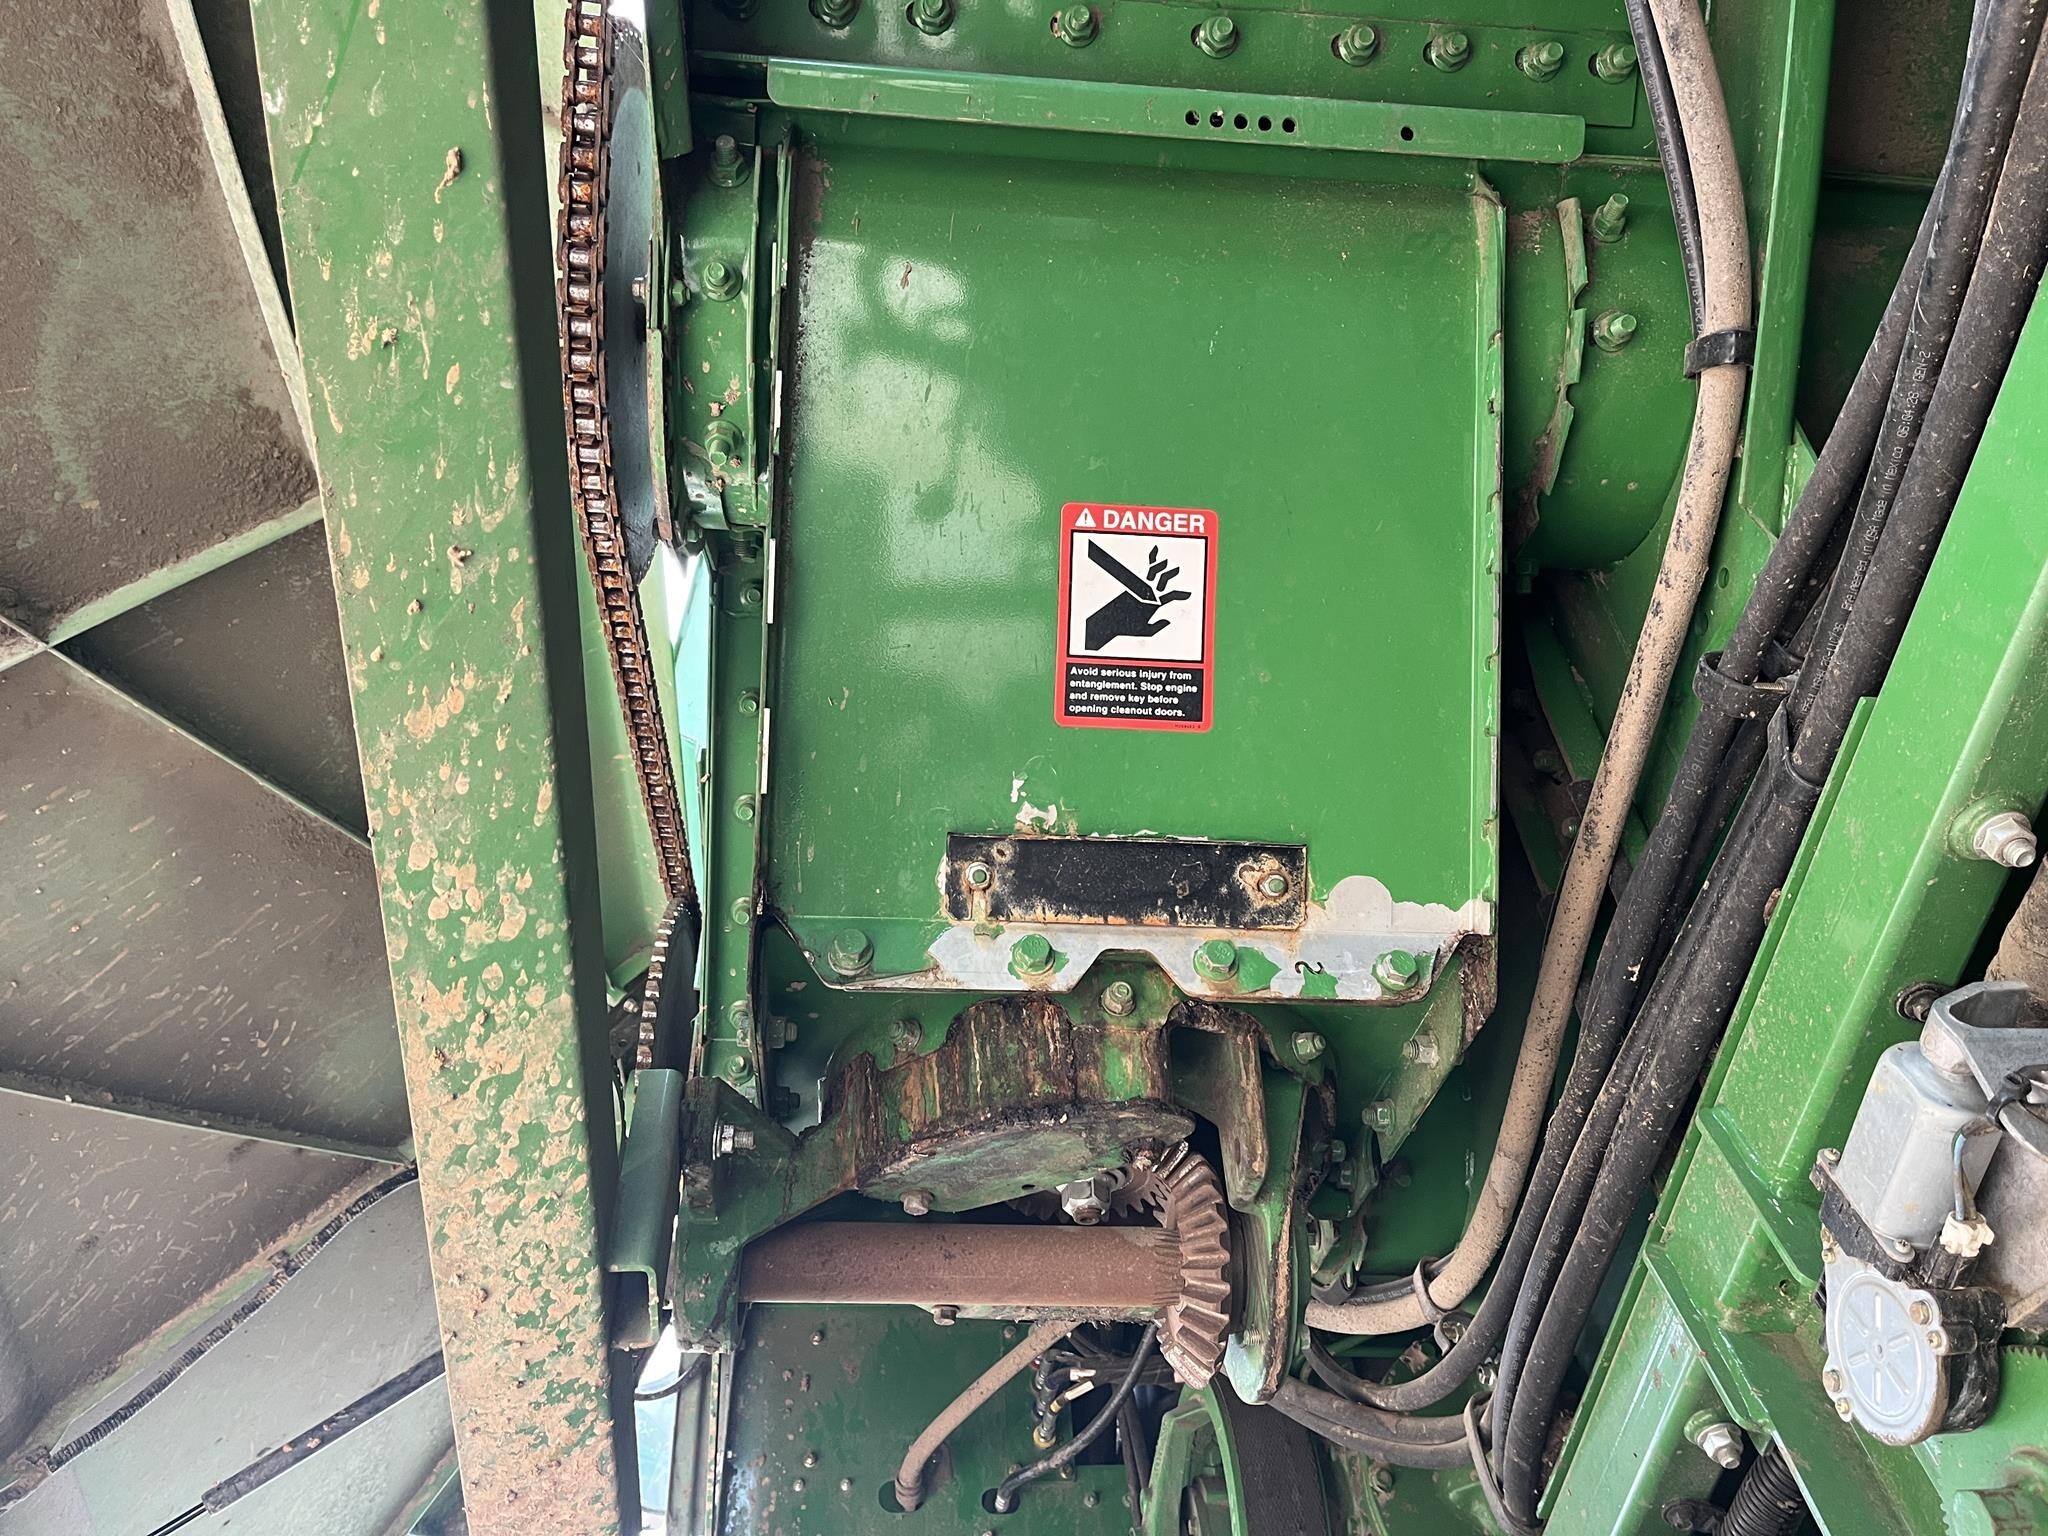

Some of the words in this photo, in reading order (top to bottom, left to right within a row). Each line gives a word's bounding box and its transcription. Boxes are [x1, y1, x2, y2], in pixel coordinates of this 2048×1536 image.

[1883, 446, 1904, 481] Mexico
[1881, 483, 1894, 495] in
[1103, 509, 1206, 534] DANGER
[1070, 666, 1099, 677] Avoid
[1100, 668, 1137, 678] serious
[1139, 669, 1167, 681] injury
[1169, 670, 1192, 680] from
[1069, 680, 1138, 691] entanglement.
[1140, 681, 1164, 692] Stop
[1165, 684, 1198, 694] engine
[1069, 691, 1088, 700] and
[1089, 693, 1126, 702] remove
[1128, 693, 1145, 704] key
[1147, 695, 1179, 704] before
[1068, 704, 1109, 715] opening
[1110, 704, 1153, 715] cleanout
[1154, 706, 1186, 717] doors.
